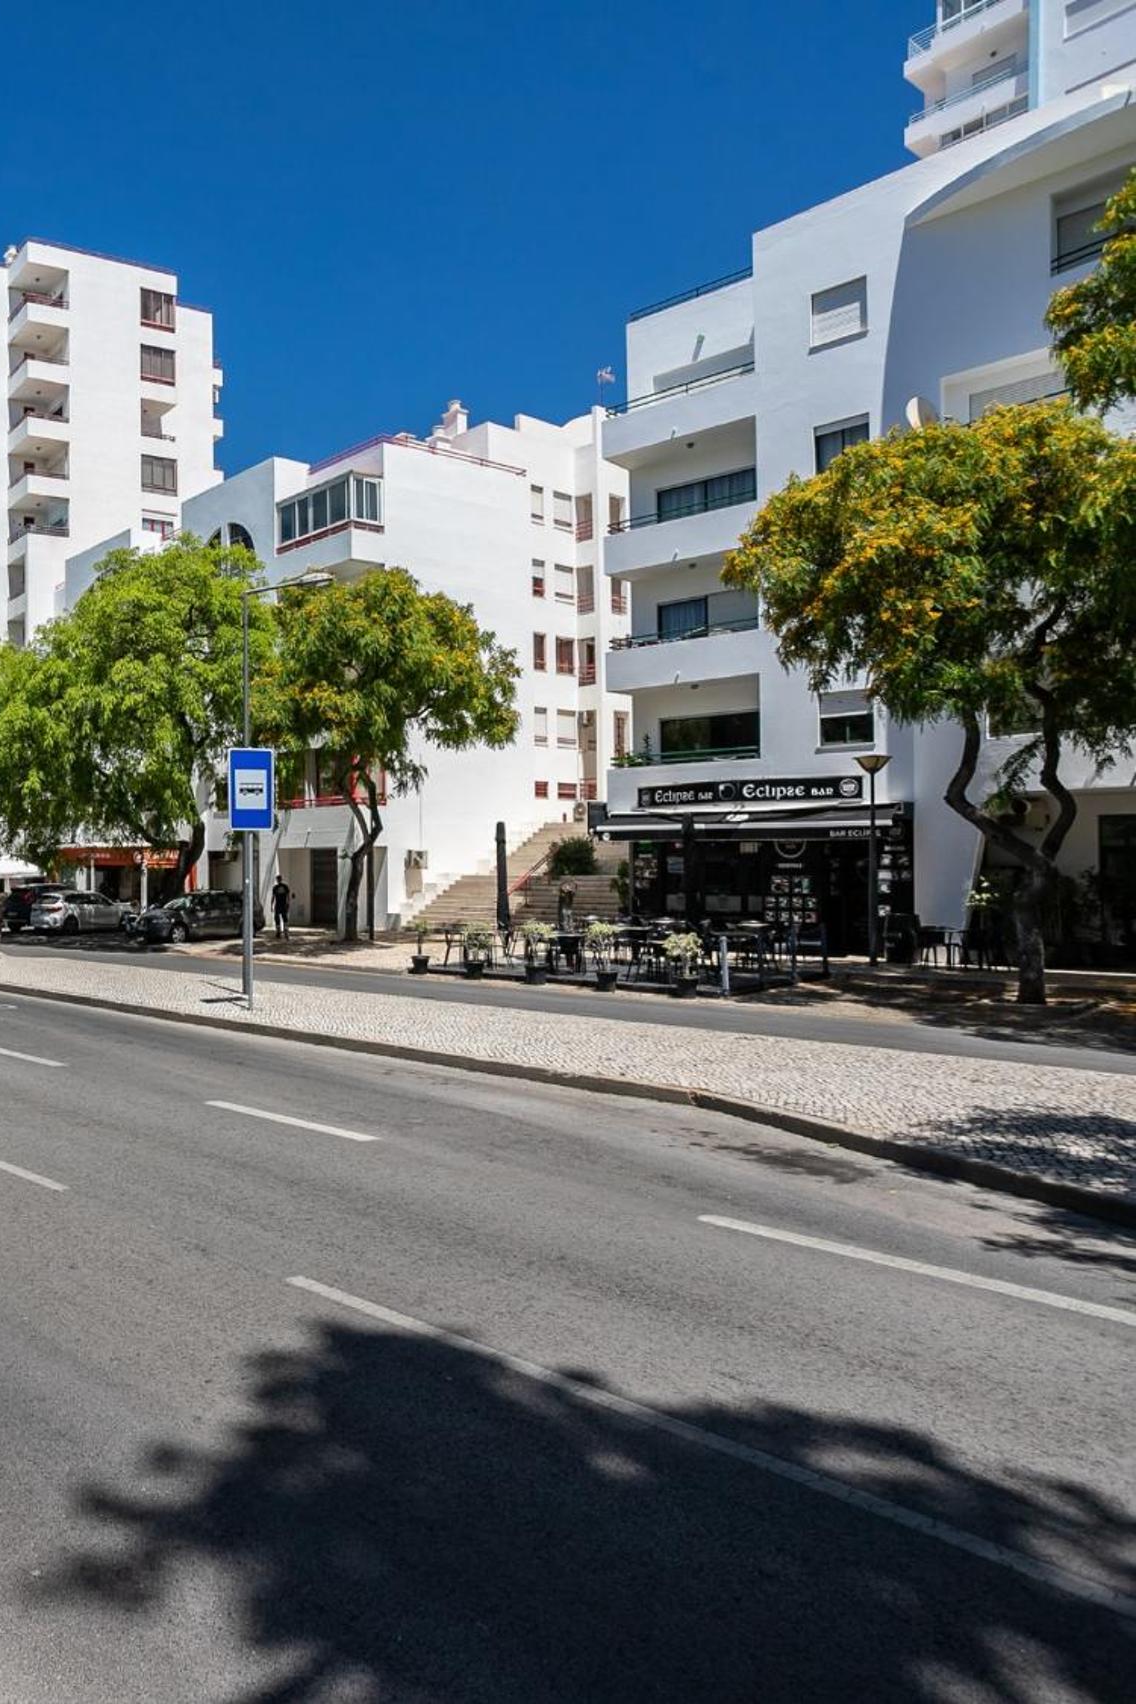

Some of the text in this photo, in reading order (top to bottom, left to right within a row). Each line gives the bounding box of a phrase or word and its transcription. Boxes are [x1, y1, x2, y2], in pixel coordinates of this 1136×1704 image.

[655, 790, 695, 803] Eclipse
[742, 784, 805, 800] Eclipse
[811, 787, 834, 796] BAR
